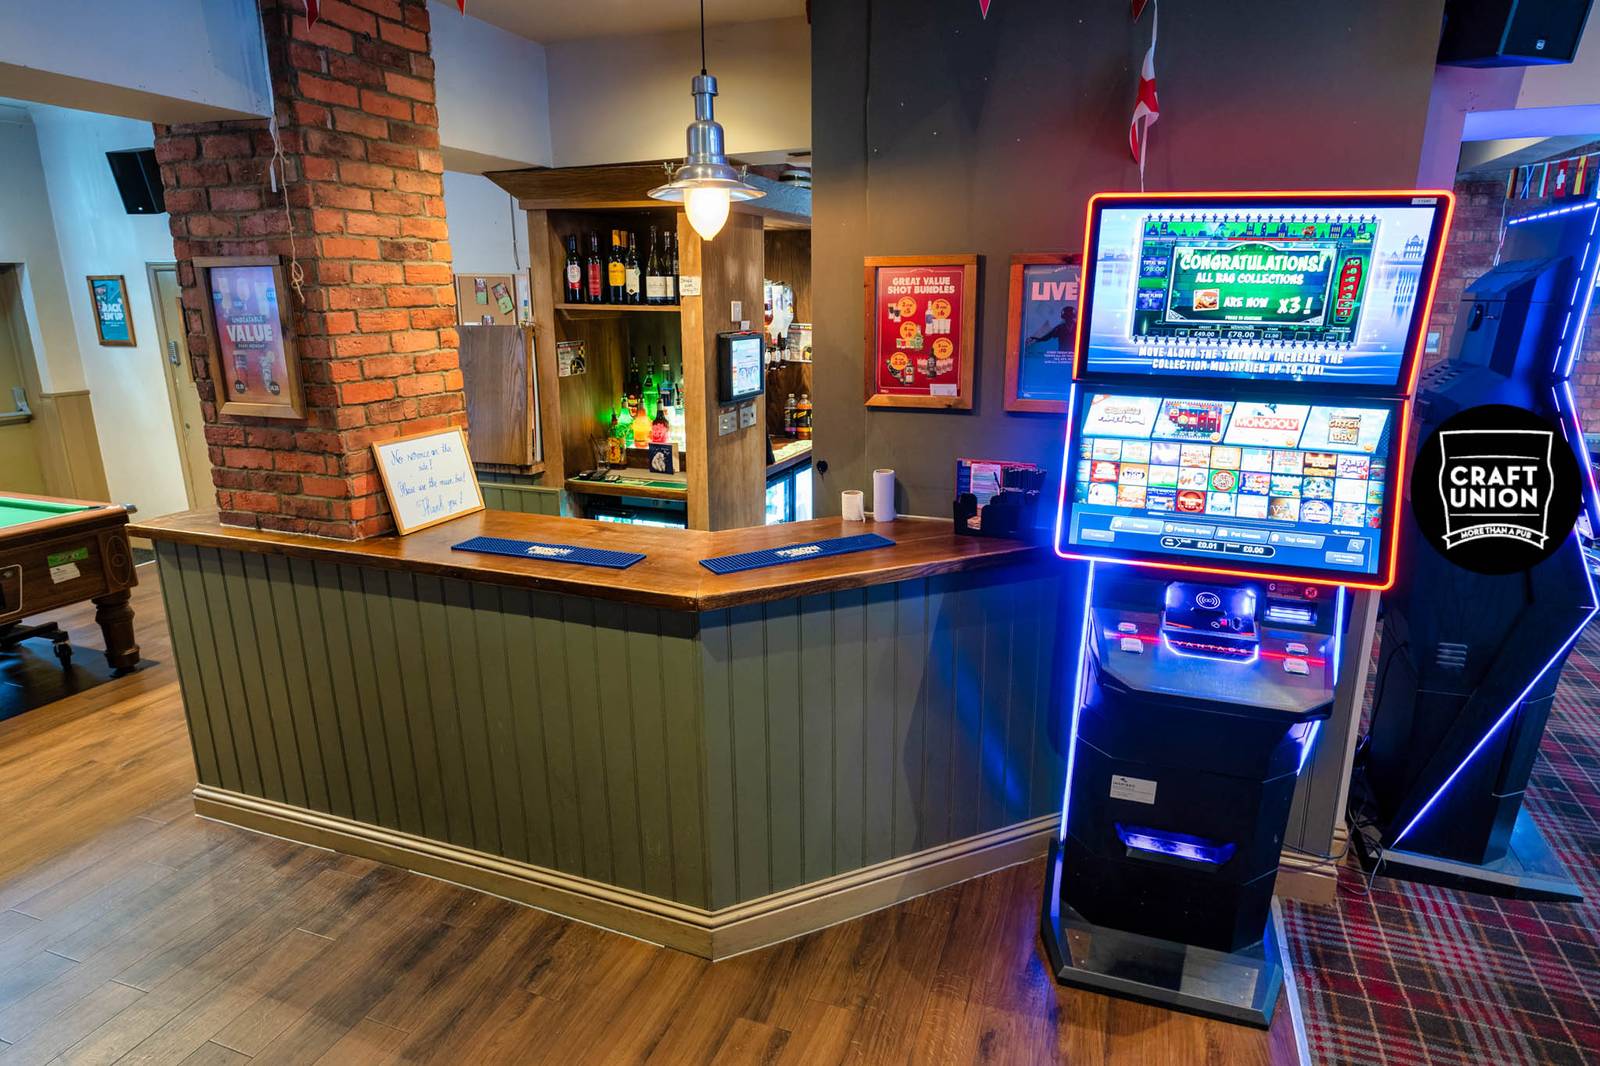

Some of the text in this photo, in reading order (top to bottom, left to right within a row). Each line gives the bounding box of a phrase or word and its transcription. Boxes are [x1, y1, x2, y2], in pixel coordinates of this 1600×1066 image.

[1180, 253, 1325, 272] CONGRATULATIONS!
[893, 276, 951, 286] GREAT VALUE
[1195, 272, 1304, 285] ALL BAG COLLECTIONS
[888, 286, 955, 295] SHOT BUNDLES
[1032, 281, 1078, 301] LIVE
[1223, 296, 1244, 308] ARE
[1246, 297, 1269, 308] NOW
[226, 324, 273, 342] VALUE
[1139, 346, 1164, 357] MOVE
[1167, 347, 1196, 358] ALONG
[1200, 349, 1218, 360] THE
[1250, 351, 1270, 362] AND
[1274, 352, 1322, 364] INCREASE
[1325, 354, 1344, 364] THE
[1152, 359, 1207, 371] COLLECTION
[1209, 361, 1265, 373] MULTIPLIER
[1268, 363, 1280, 374] UP
[1285, 364, 1297, 375] TO
[1236, 417, 1298, 430] MONOPOLY
[1197, 541, 1217, 549] £0.01
[1243, 545, 1264, 554] £0.00
[1176, 640, 1248, 654] VANTAGE
